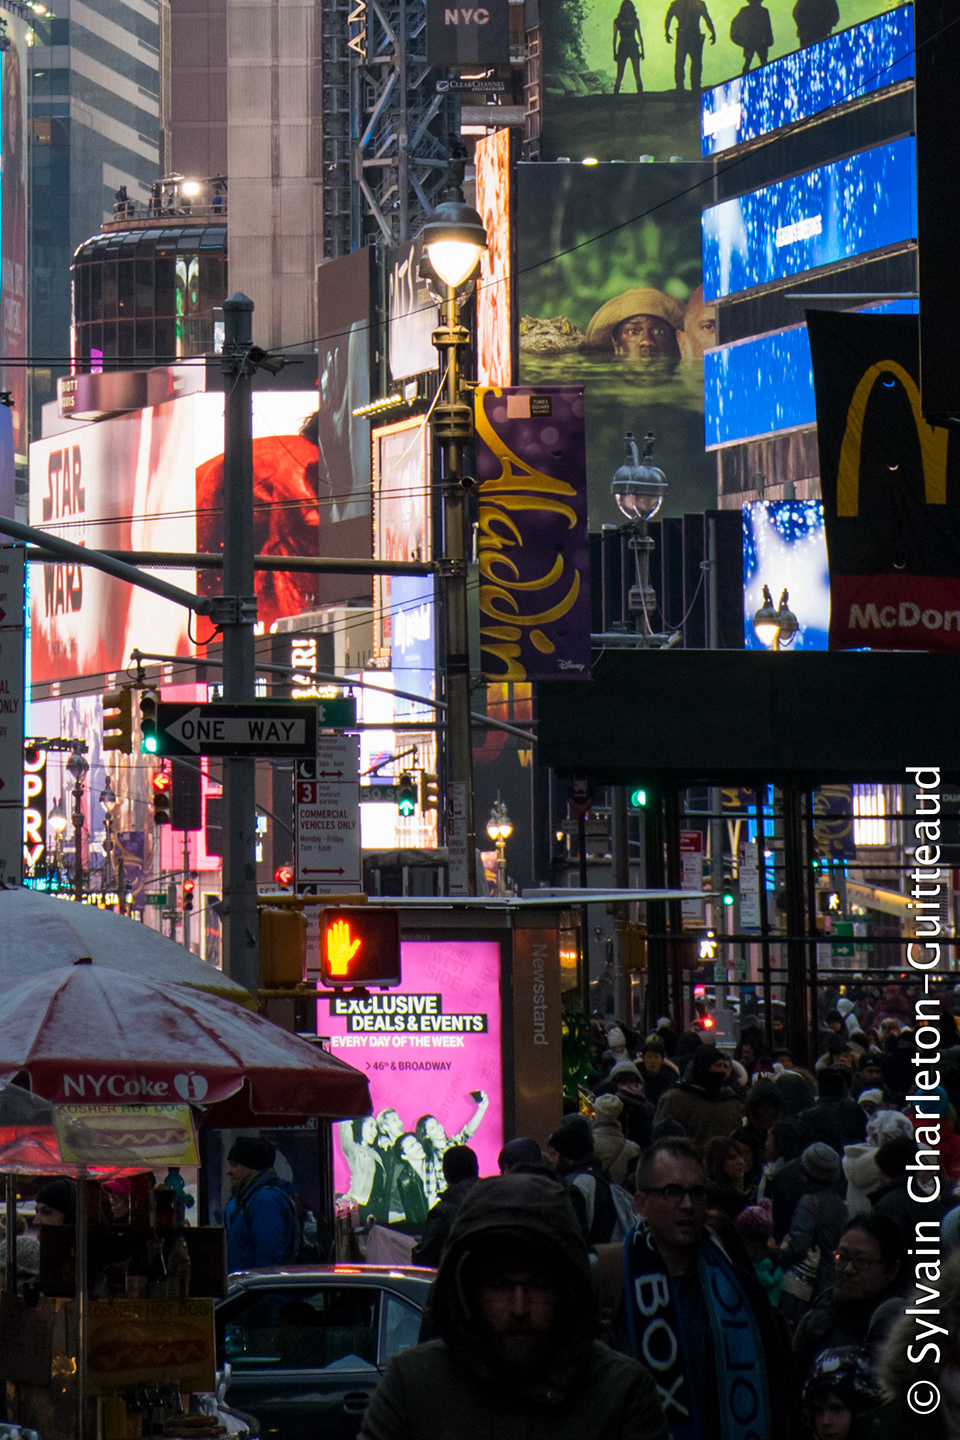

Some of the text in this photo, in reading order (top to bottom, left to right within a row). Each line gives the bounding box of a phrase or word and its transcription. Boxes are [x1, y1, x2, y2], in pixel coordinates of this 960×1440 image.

[444, 8, 490, 26] NYC
[42, 444, 86, 523] STAR
[182, 718, 297, 742] ONE WAY
[302, 783, 313, 803] 3
[362, 789, 381, 800] 50
[300, 809, 348, 819] COMMERCIAL
[300, 820, 357, 830] VEHICLES ONLY
[532, 943, 550, 1046] Newsstand
[335, 995, 438, 1015] EXCLUSIVE
[352, 1014, 484, 1031] DEALS & EVENTS
[331, 1035, 465, 1048] EVERY DAY OF THE WEEK
[398, 1061, 452, 1071] BROADWAY
[633, 1271, 691, 1419] BOX
